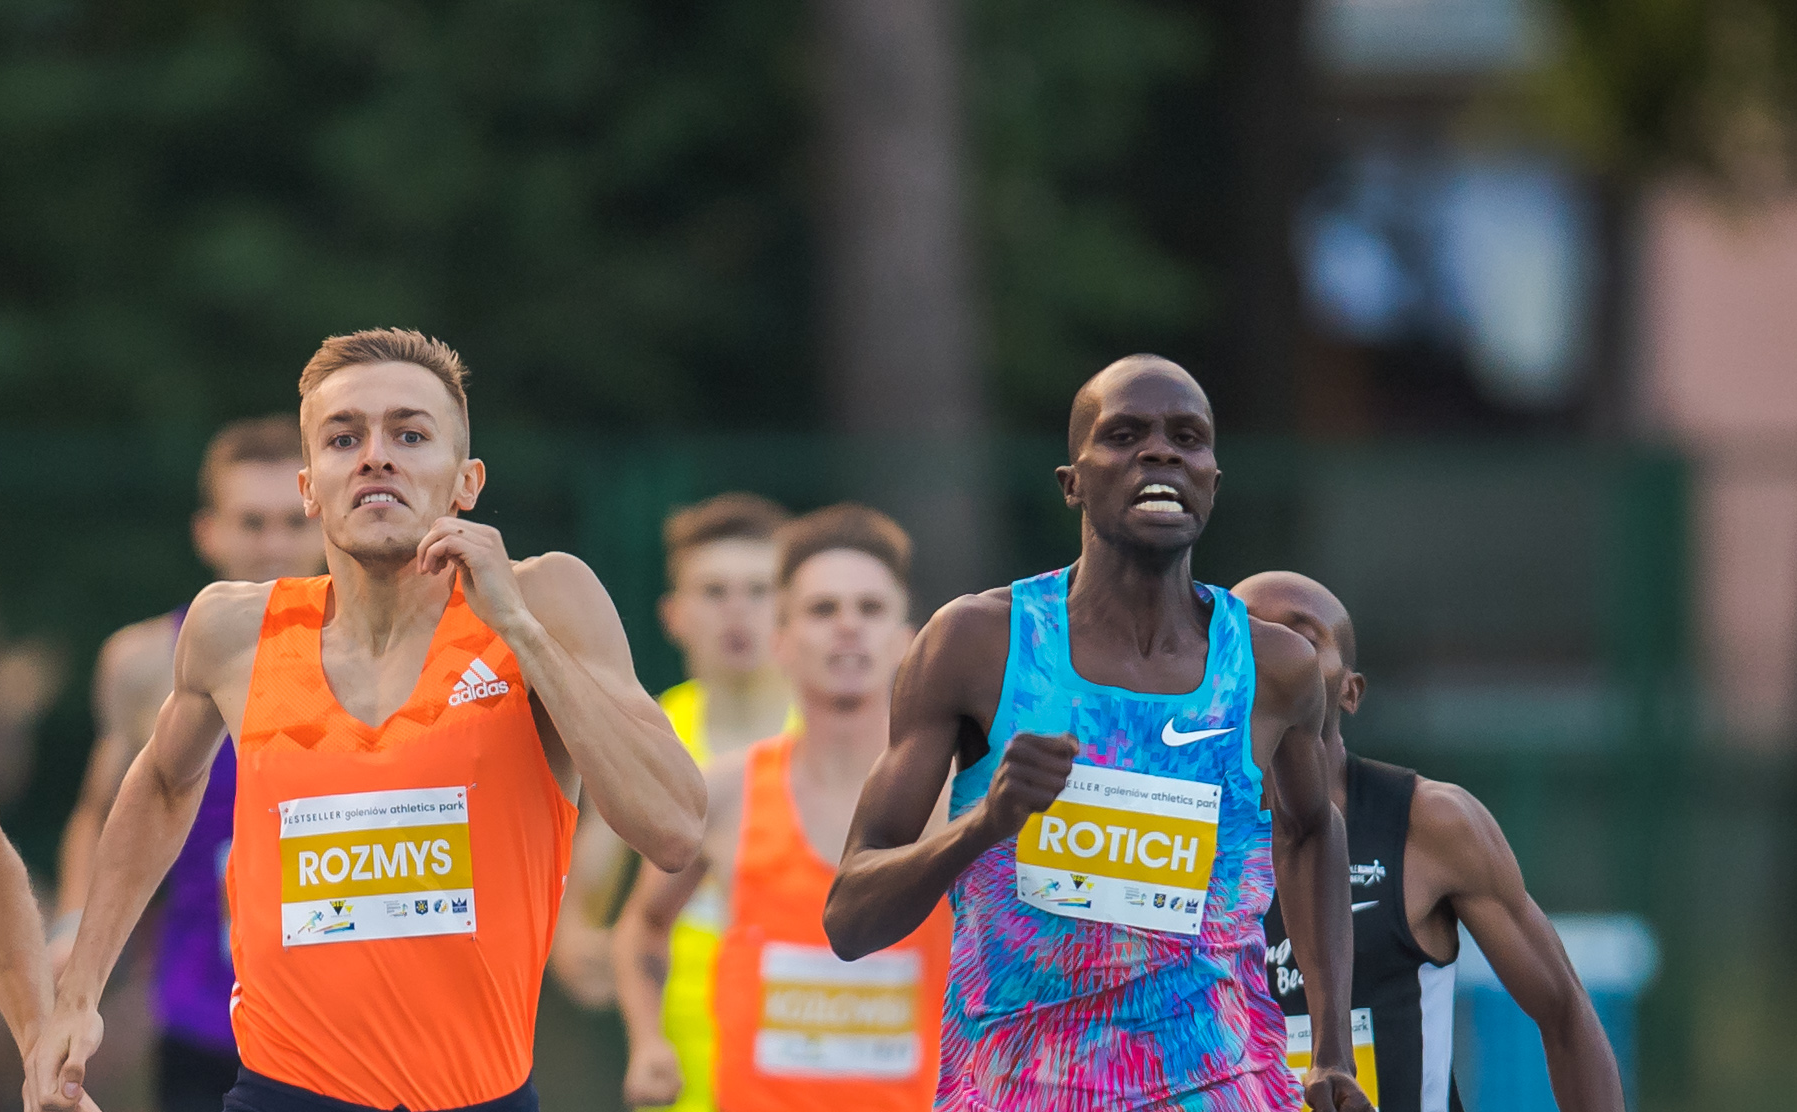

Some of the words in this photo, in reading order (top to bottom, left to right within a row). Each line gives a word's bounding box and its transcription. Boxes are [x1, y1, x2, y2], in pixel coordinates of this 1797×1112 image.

[448, 681, 509, 706] adidas
[1104, 785, 1149, 799] goleniów
[1151, 792, 1194, 805] athletics
[1196, 798, 1217, 810] park
[345, 807, 387, 821] goleniów
[390, 802, 435, 814] athletics
[439, 801, 465, 813] park
[1038, 815, 1199, 873] ROTICH
[298, 838, 452, 887] ROZMYS
[1352, 1023, 1369, 1033] ark
